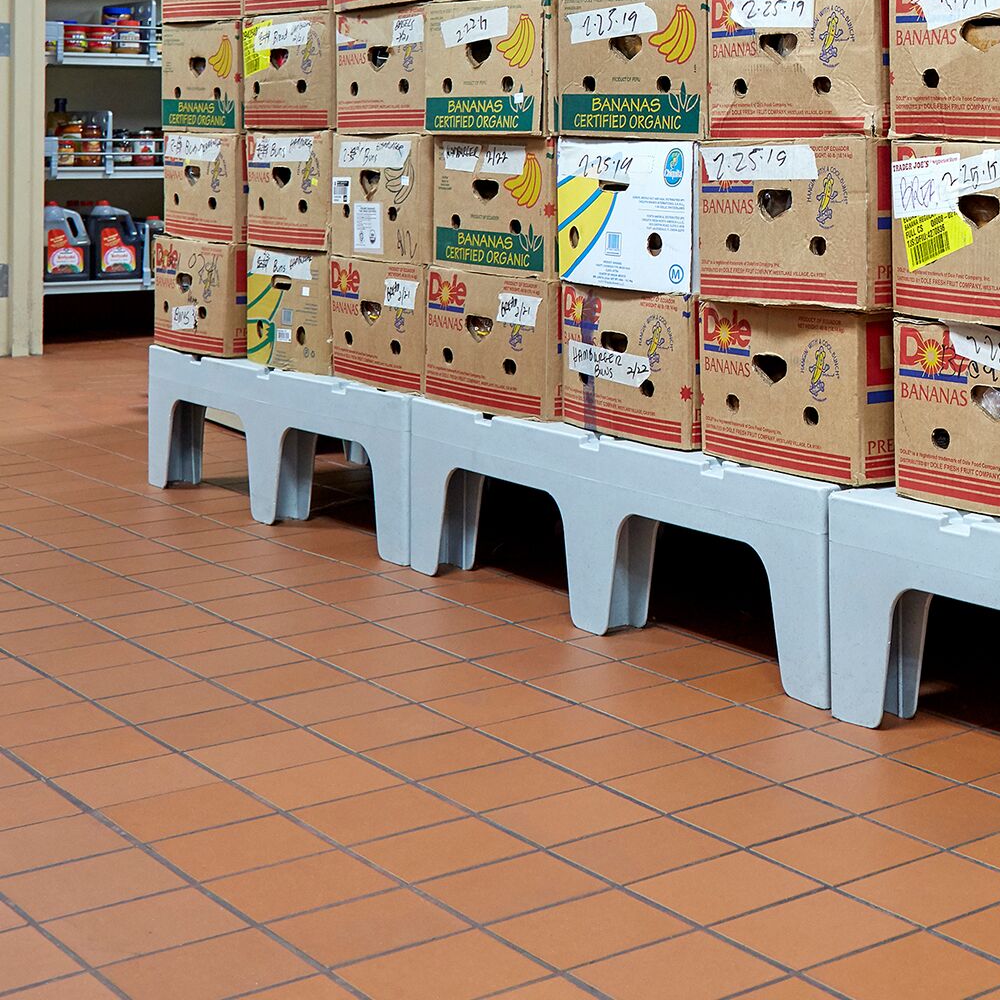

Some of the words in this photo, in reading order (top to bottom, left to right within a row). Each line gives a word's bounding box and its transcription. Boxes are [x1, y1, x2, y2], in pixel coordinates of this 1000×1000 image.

[896, 29, 957, 46] BANANAS
[712, 41, 756, 58] BANANAS
[339, 53, 366, 66] BANANAS
[178, 102, 215, 114] BANANAS
[448, 100, 502, 113] BANANAS
[592, 98, 660, 112] BANANAS
[169, 114, 196, 126] CERTIFIED
[198, 114, 225, 126] ORGANIC
[435, 115, 475, 128] CERTIFIED
[477, 115, 519, 128] ORGANIC
[574, 114, 627, 128] CERTIFIED
[630, 115, 681, 130] ORGANIC
[893, 163, 912, 172] TRADER
[703, 200, 753, 214] BANANAS
[458, 232, 513, 249] BANANAS
[446, 246, 484, 260] CERTIFIED
[487, 251, 529, 267] ORGANIC
[332, 261, 360, 293] Dole
[429, 272, 467, 306] Dole
[332, 302, 358, 316] BANANAS
[428, 314, 462, 331] BANANAS
[704, 306, 751, 348] Dole
[705, 359, 750, 378] BANANAS
[901, 383, 967, 406] BANANAS
